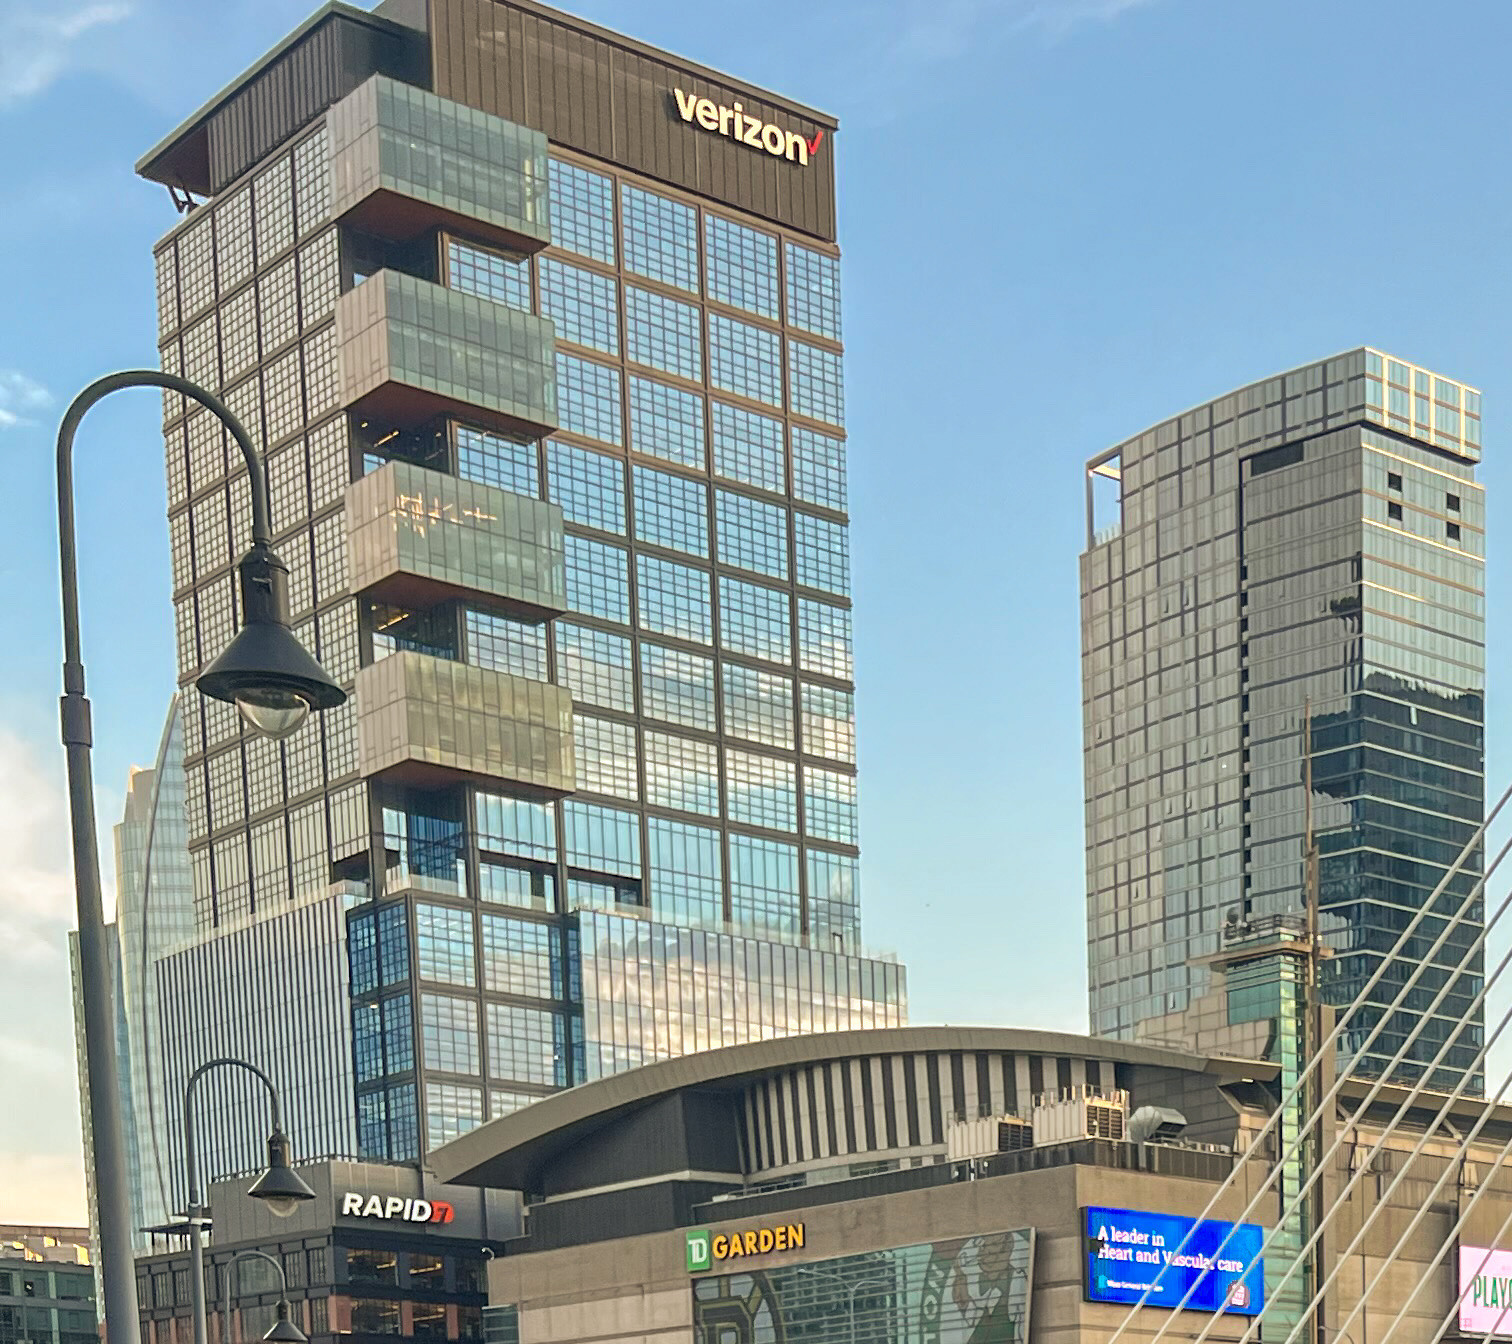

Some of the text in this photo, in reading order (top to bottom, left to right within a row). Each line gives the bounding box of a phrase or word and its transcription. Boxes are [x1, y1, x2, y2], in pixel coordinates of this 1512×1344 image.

[673, 88, 808, 166] verizon
[342, 1192, 455, 1223] RAPID7
[688, 1223, 804, 1264] TD GARDEN
[1097, 1225, 1165, 1247] A leader in
[1097, 1243, 1133, 1262] Heart
[1136, 1248, 1160, 1264] and
[1217, 1259, 1244, 1273] care
